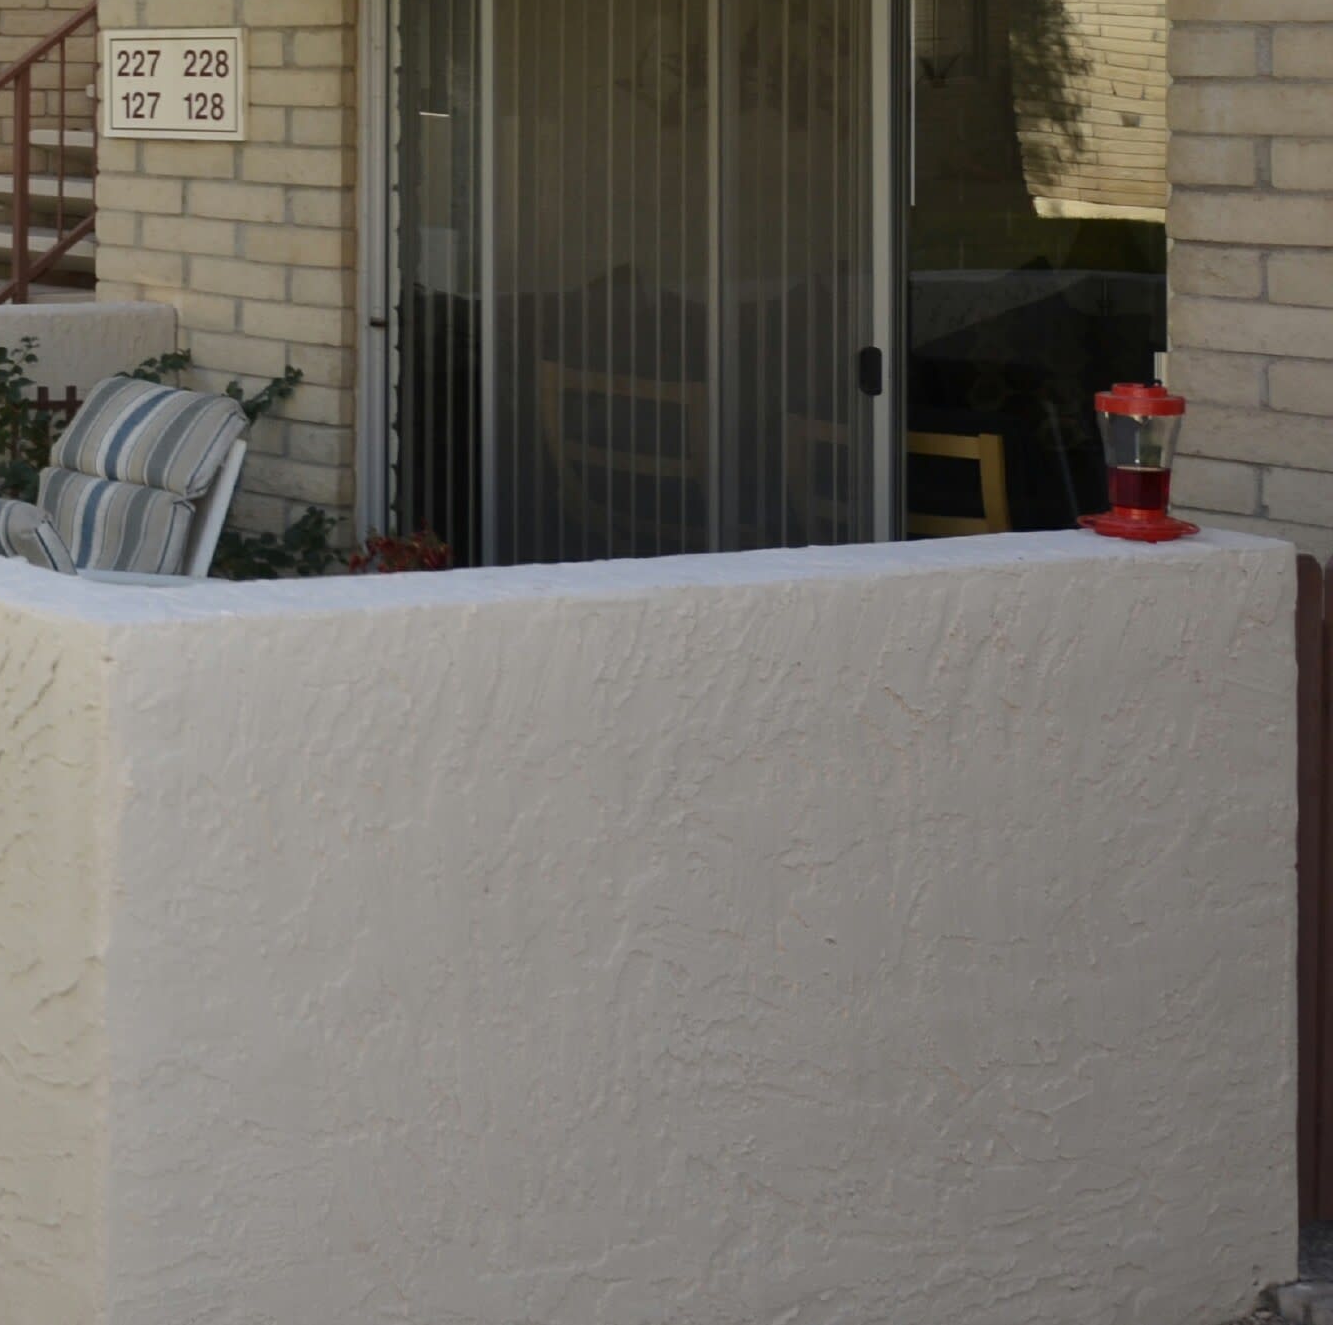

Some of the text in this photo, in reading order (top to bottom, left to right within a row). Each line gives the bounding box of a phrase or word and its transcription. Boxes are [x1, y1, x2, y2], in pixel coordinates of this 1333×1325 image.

[117, 49, 229, 78] 227 228
[121, 91, 224, 121] 127 128
